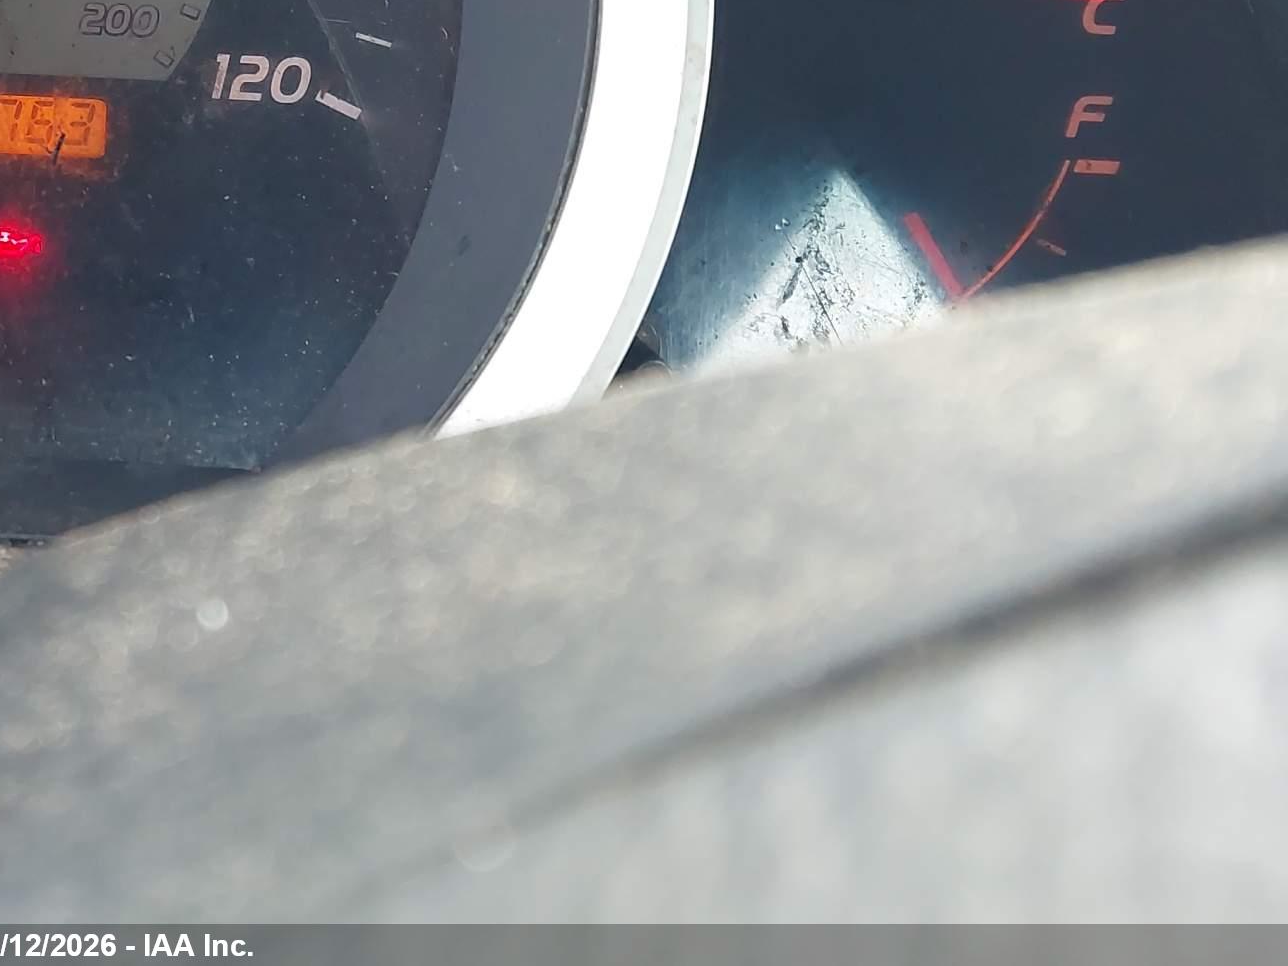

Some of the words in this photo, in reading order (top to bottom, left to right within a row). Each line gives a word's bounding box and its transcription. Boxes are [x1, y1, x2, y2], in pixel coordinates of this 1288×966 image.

[78, 2, 160, 38] 200
[212, 53, 312, 104] 120
[1065, 95, 1115, 138] F
